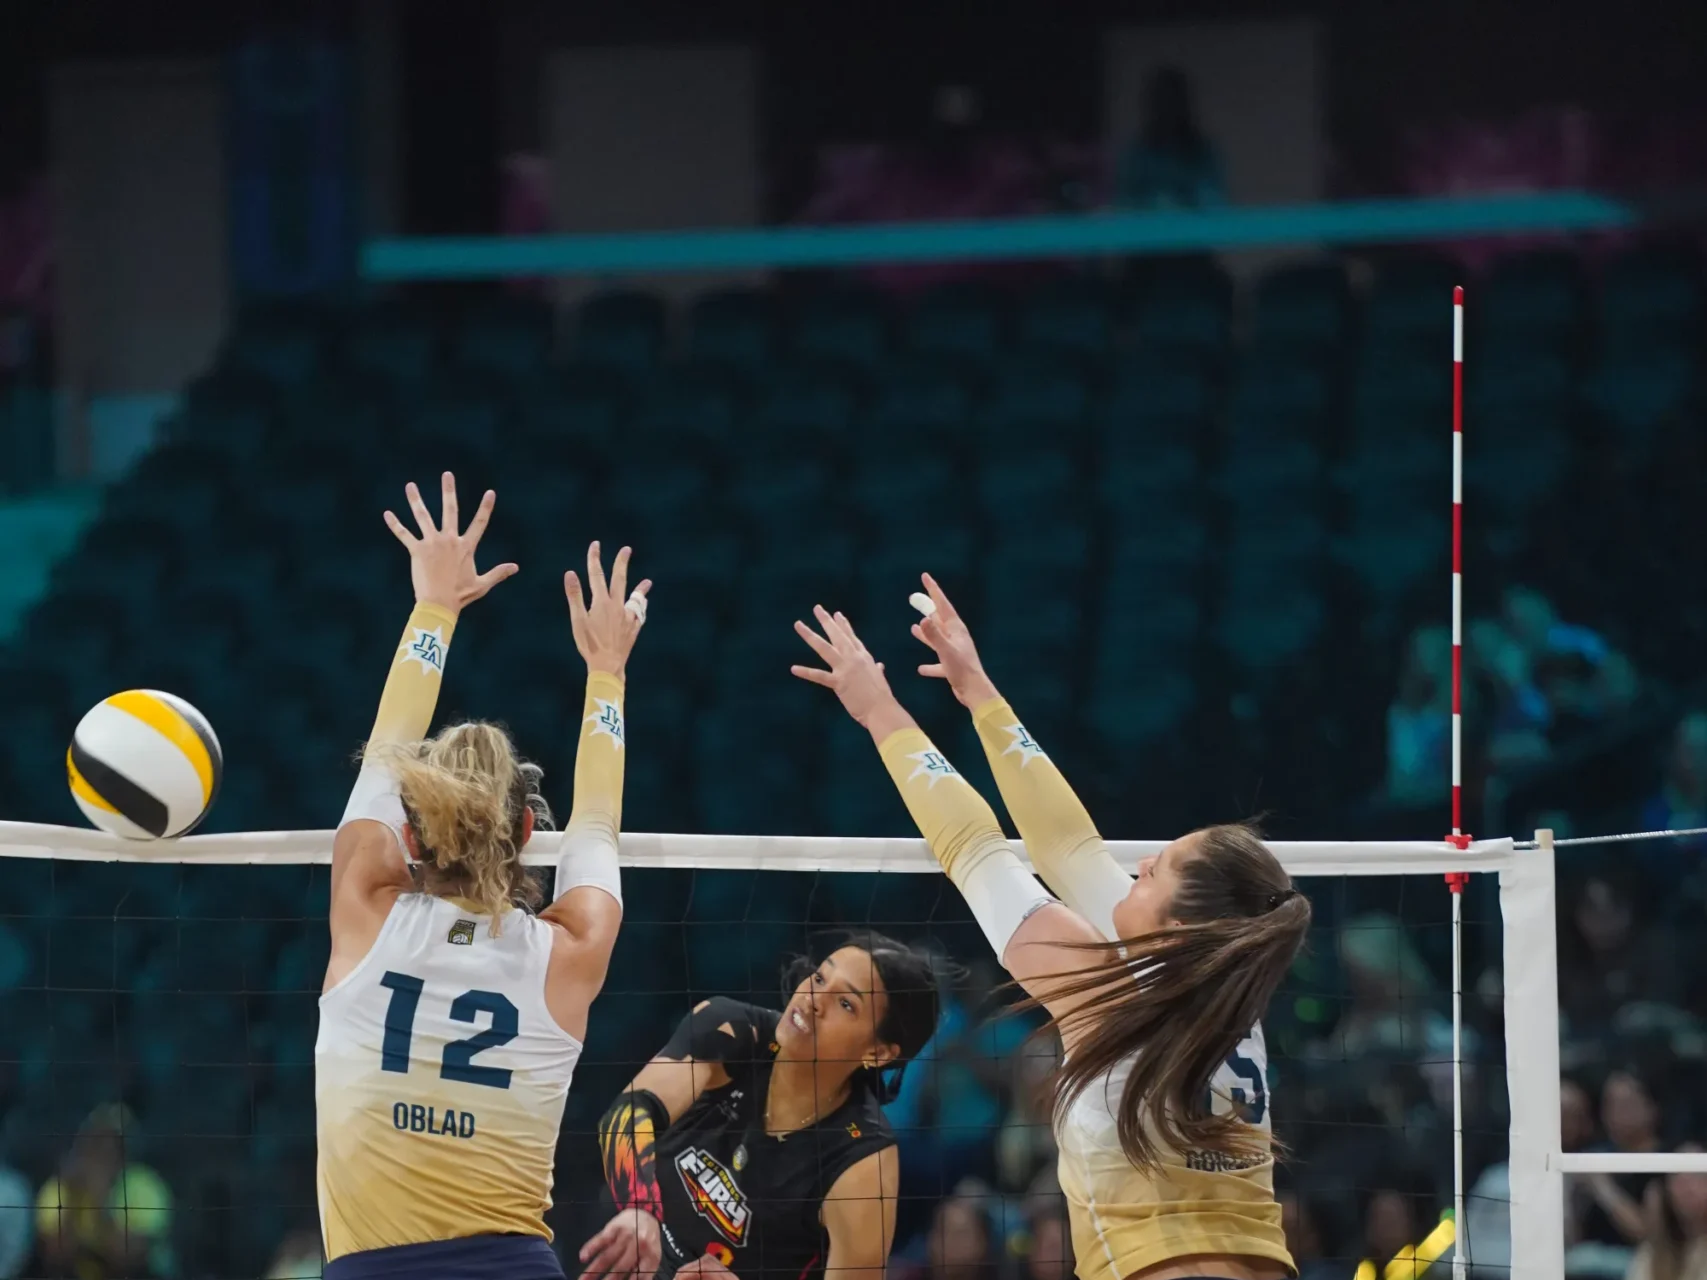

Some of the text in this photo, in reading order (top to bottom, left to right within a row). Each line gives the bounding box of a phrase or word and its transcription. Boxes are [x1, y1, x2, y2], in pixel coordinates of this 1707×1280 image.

[380, 970, 519, 1090] 12
[393, 1102, 475, 1139] OBLAD
[679, 1151, 748, 1229] FURY
[701, 1155, 741, 1201] COLUMBUS
